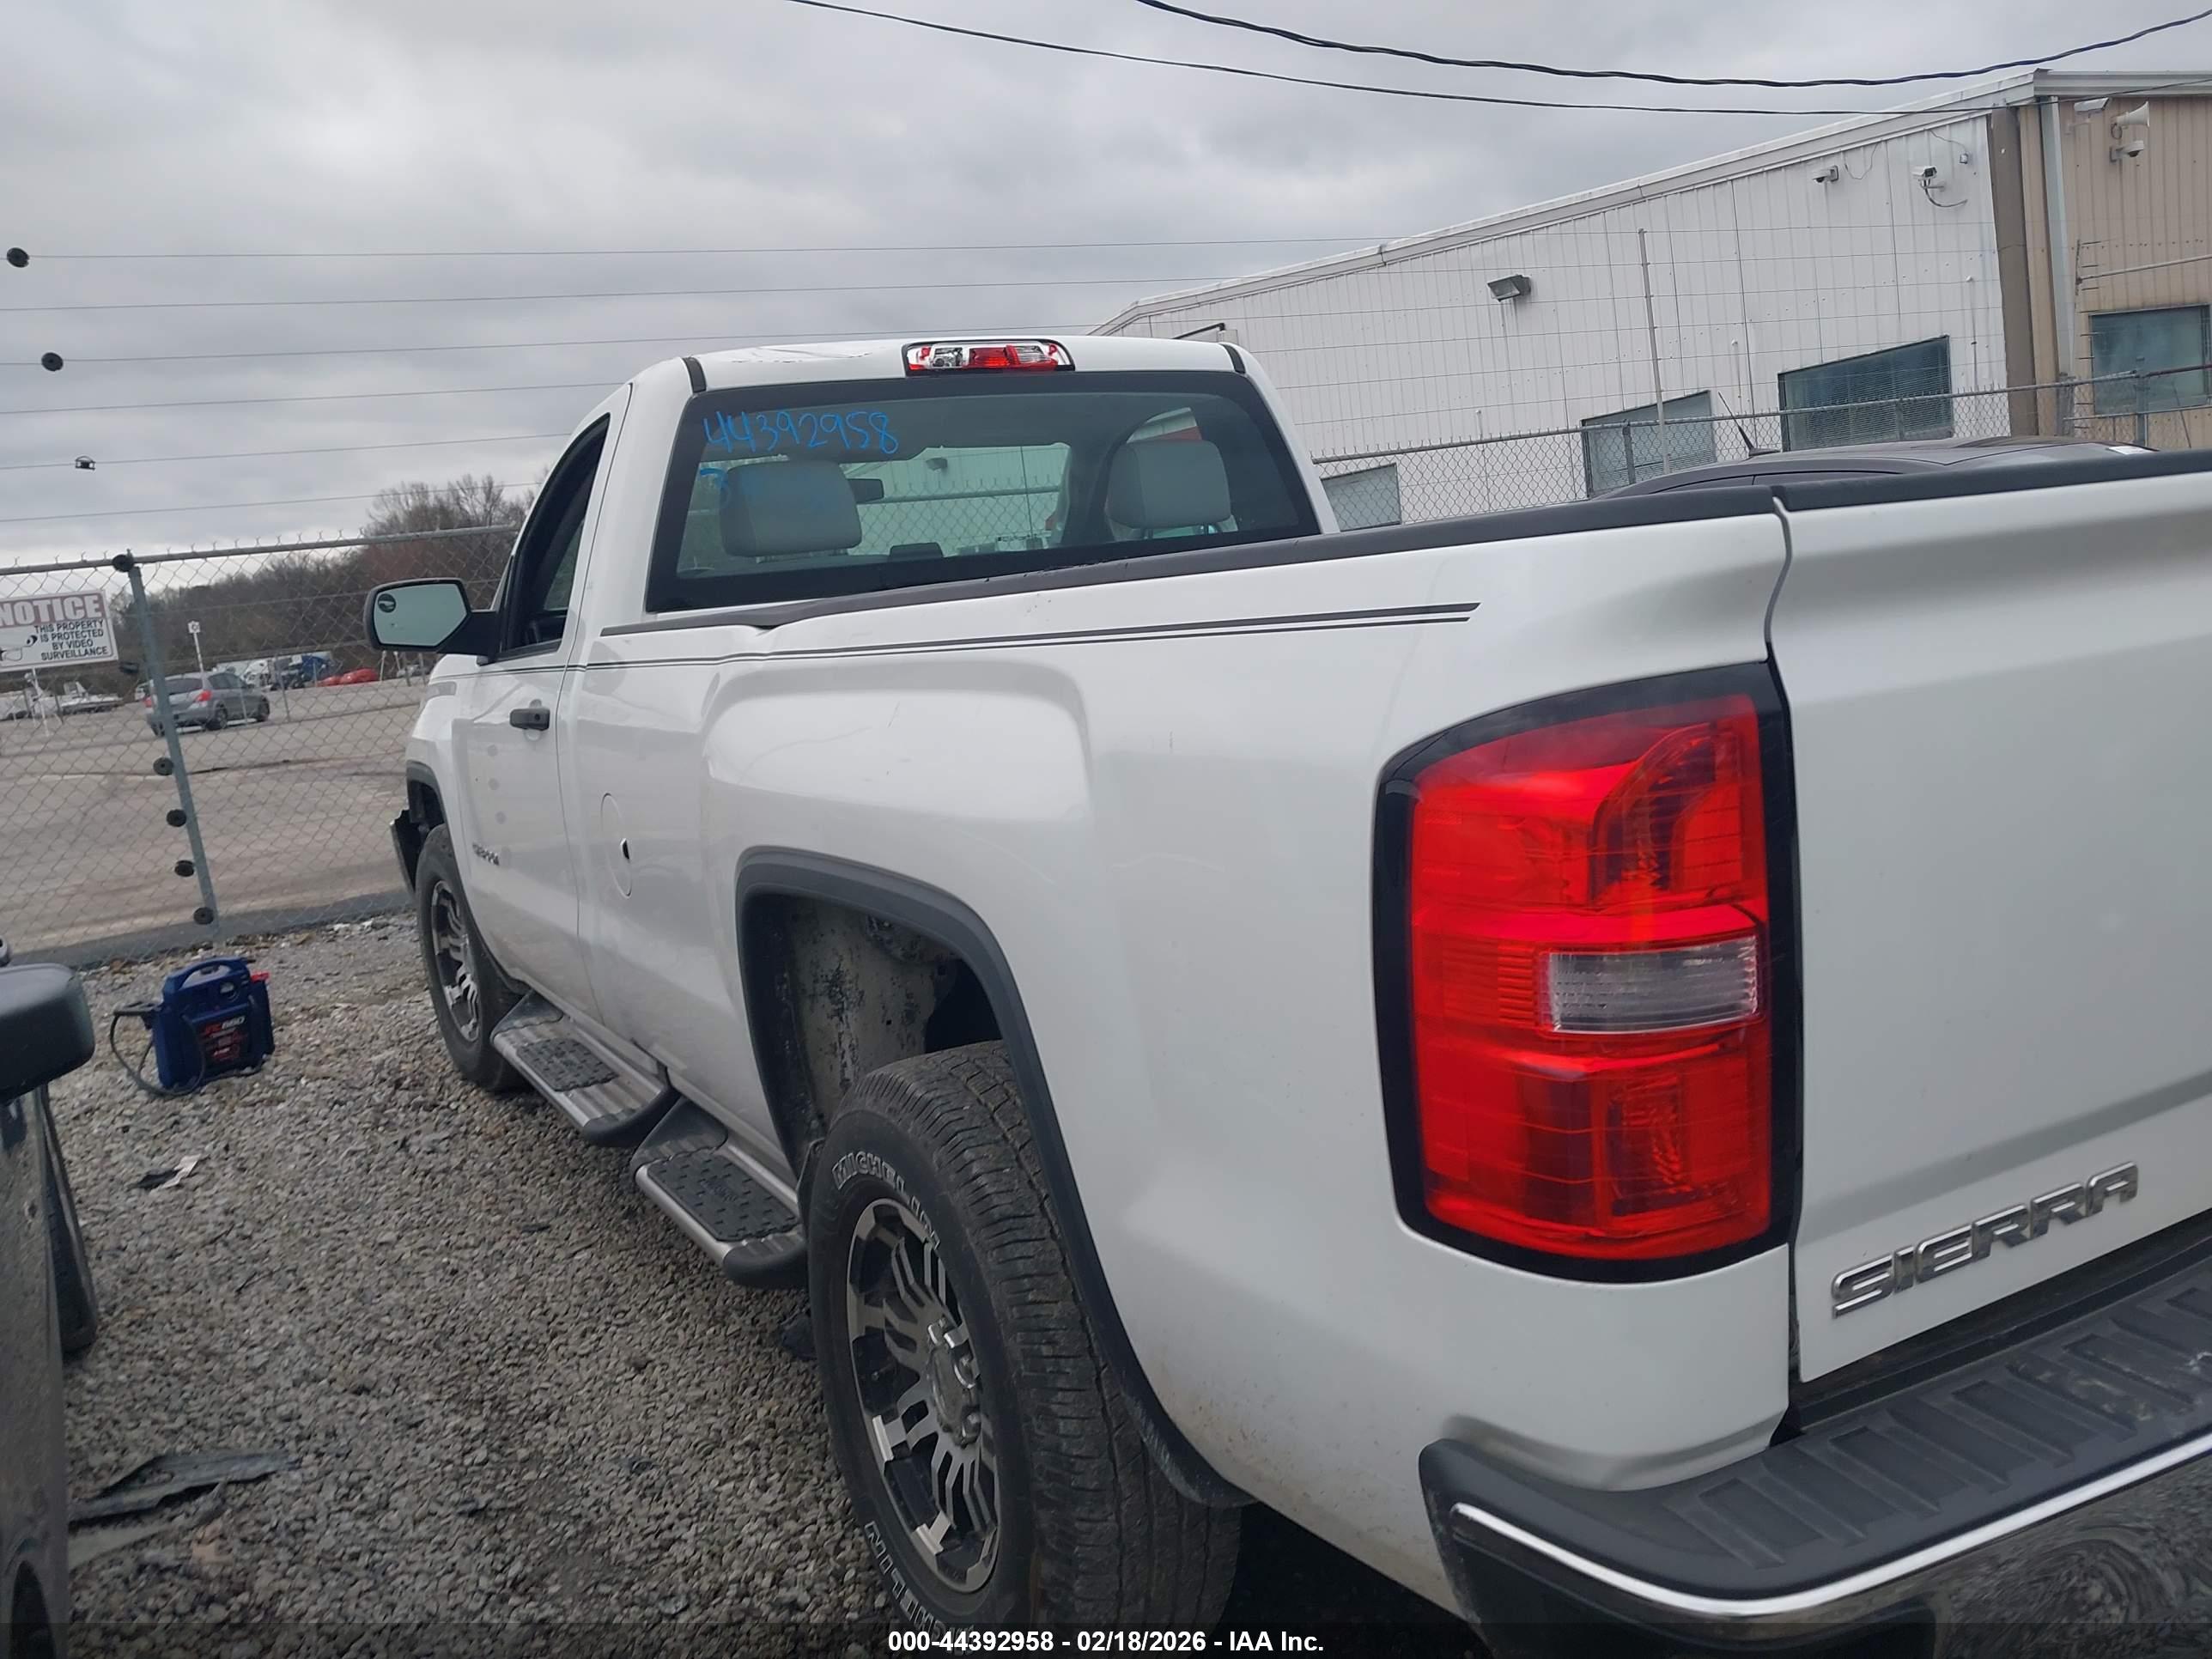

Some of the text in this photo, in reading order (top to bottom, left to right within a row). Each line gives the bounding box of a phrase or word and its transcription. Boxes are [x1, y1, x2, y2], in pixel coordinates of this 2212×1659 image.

[703, 410, 898, 454] 44392958
[0, 594, 103, 626] NOTICE
[34, 619, 103, 634] THIS PROPERTY
[40, 629, 104, 643] IS PROTECTED
[52, 638, 94, 651] BY VIDEO
[40, 646, 107, 660] SURVEILLANCE
[1832, 1161, 2139, 1319] SIERRA
